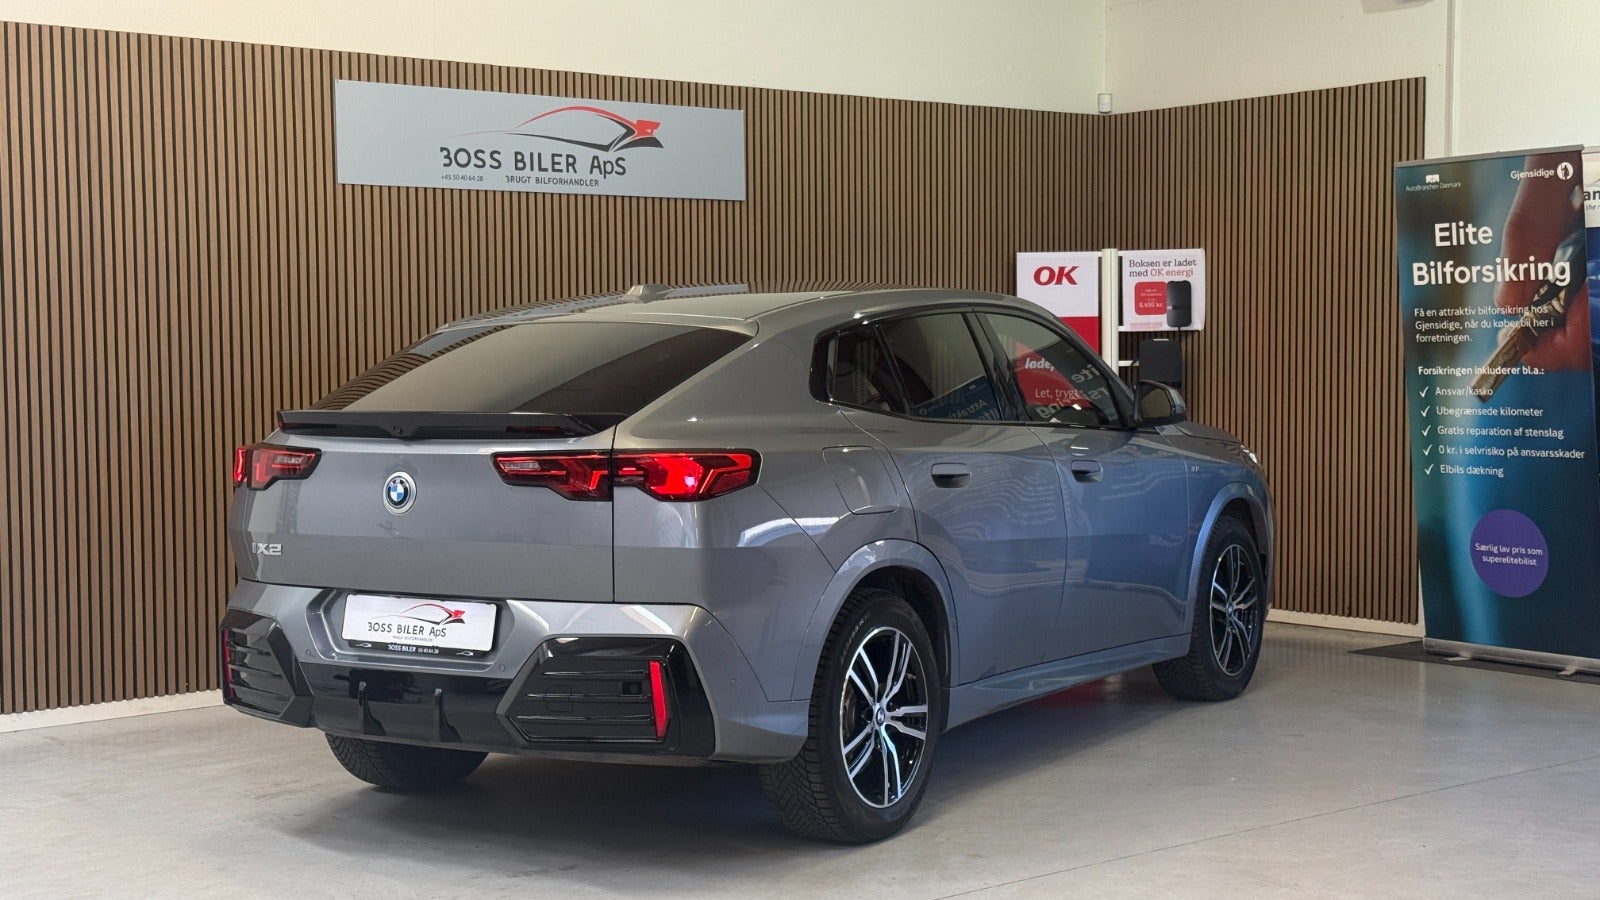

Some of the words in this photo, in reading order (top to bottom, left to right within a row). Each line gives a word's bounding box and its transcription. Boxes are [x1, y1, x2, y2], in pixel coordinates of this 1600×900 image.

[514, 151, 577, 174] BILER
[589, 156, 627, 179] ApS
[1511, 168, 1554, 180] Gjensidige
[536, 177, 599, 187] BILFORHANDLER
[1406, 184, 1438, 192] AutoBranchen
[1435, 221, 1493, 247] Elite
[1033, 266, 1078, 286] OK
[1166, 268, 1193, 278] energi
[1412, 256, 1571, 286] Bilforsikring
[1414, 308, 1425, 317] Få
[1439, 306, 1476, 316] attraktiv
[1478, 306, 1529, 316] bilforsikring
[1531, 306, 1548, 314] hos
[1415, 320, 1463, 331] Gjensidige,
[1465, 320, 1478, 329] når
[1481, 319, 1491, 328] du
[1493, 319, 1518, 328] køber
[1520, 318, 1530, 327] bil
[1533, 318, 1548, 326] her
[1416, 334, 1472, 344] forretningen.
[1418, 366, 1472, 376] Forsikringen
[1474, 366, 1520, 375] inkluderer
[1435, 386, 1493, 397] Ansvar/kasko
[1436, 406, 1498, 417] Ubegrænsede
[1500, 407, 1543, 417] kilometer
[1437, 426, 1464, 435] Gratis
[1466, 426, 1511, 437] reparation
[1514, 426, 1523, 436] af
[1525, 427, 1564, 439] stenslag
[1438, 446, 1444, 454] 0
[1446, 446, 1458, 454] kr.
[1464, 446, 1504, 456] selvrisiko
[1507, 447, 1519, 458] på
[1520, 448, 1585, 459] ansvarsskader
[1440, 464, 1464, 474] Elbils
[1466, 465, 1504, 477] dækning
[252, 543, 282, 555] iX2
[1475, 543, 1498, 553] Særlig
[1500, 545, 1510, 553] lav
[1512, 546, 1526, 555] pris
[1482, 555, 1537, 566] superelitebilist
[397, 624, 424, 635] BILER
[429, 627, 446, 638] ApS
